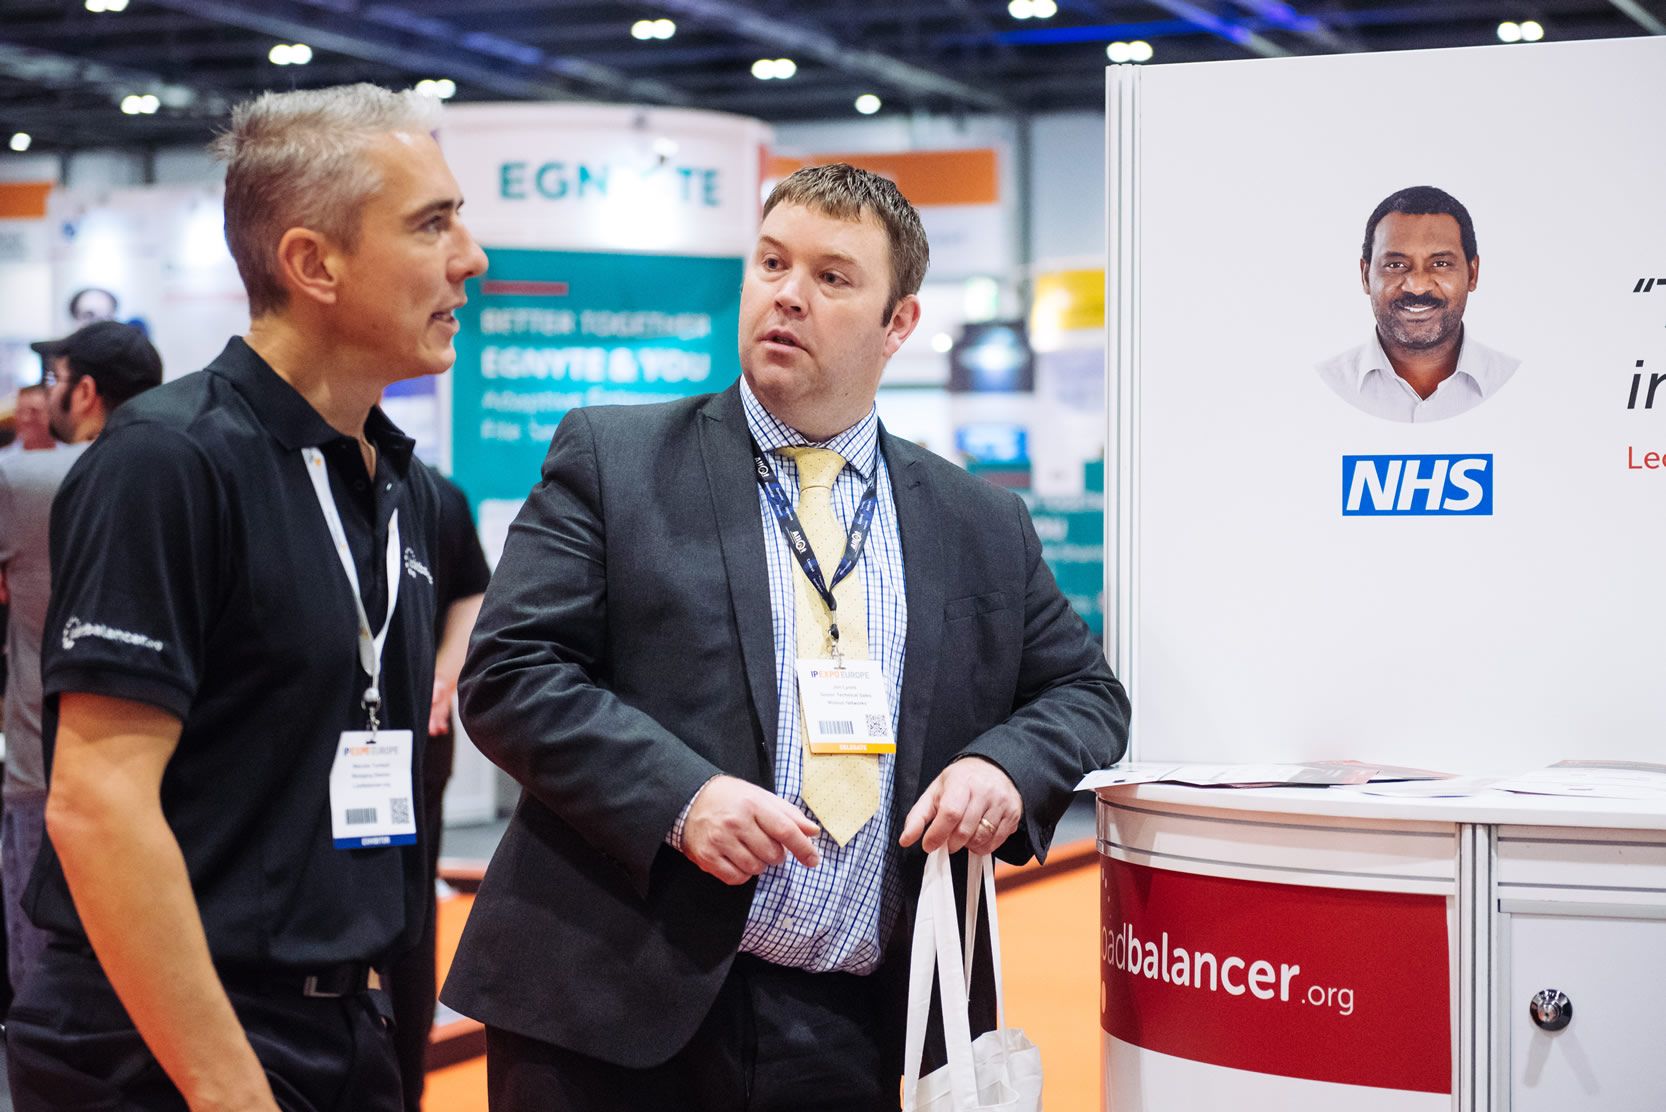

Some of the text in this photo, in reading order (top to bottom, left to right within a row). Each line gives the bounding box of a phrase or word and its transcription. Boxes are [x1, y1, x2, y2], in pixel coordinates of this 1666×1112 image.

[499, 162, 722, 206] EGNTE
[1628, 446, 1666, 469] Le
[1346, 456, 1488, 512] NHS
